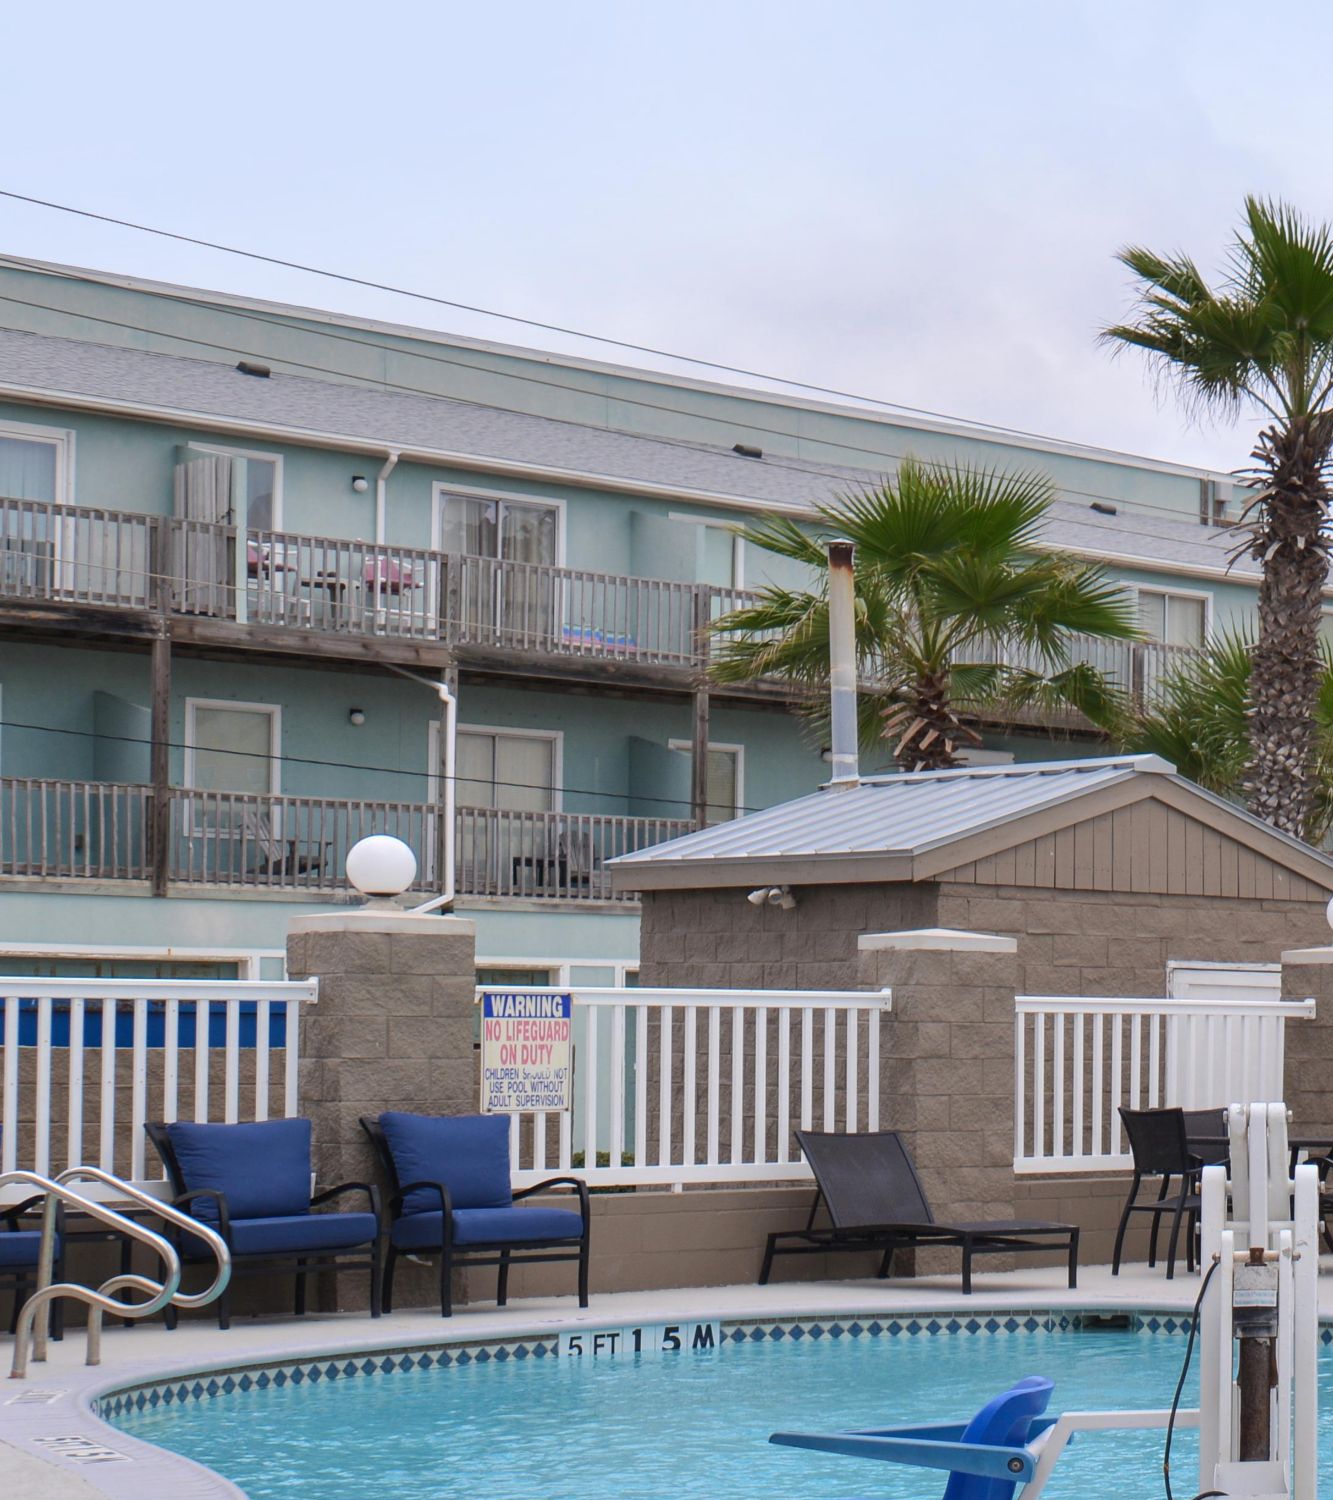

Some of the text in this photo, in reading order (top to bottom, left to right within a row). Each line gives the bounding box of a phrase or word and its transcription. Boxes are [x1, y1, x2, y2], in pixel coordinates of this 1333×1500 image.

[491, 995, 563, 1017] WARNING
[485, 1020, 569, 1041] NO LIFEGUARD
[500, 1044, 553, 1065] ON DUTY
[485, 1068, 519, 1080] CHILDREN
[554, 1068, 567, 1079] NOT
[490, 1081, 564, 1093] USE POOL WITHOUT
[488, 1094, 564, 1107] ADULT SUPERVISION
[692, 1324, 714, 1348] M
